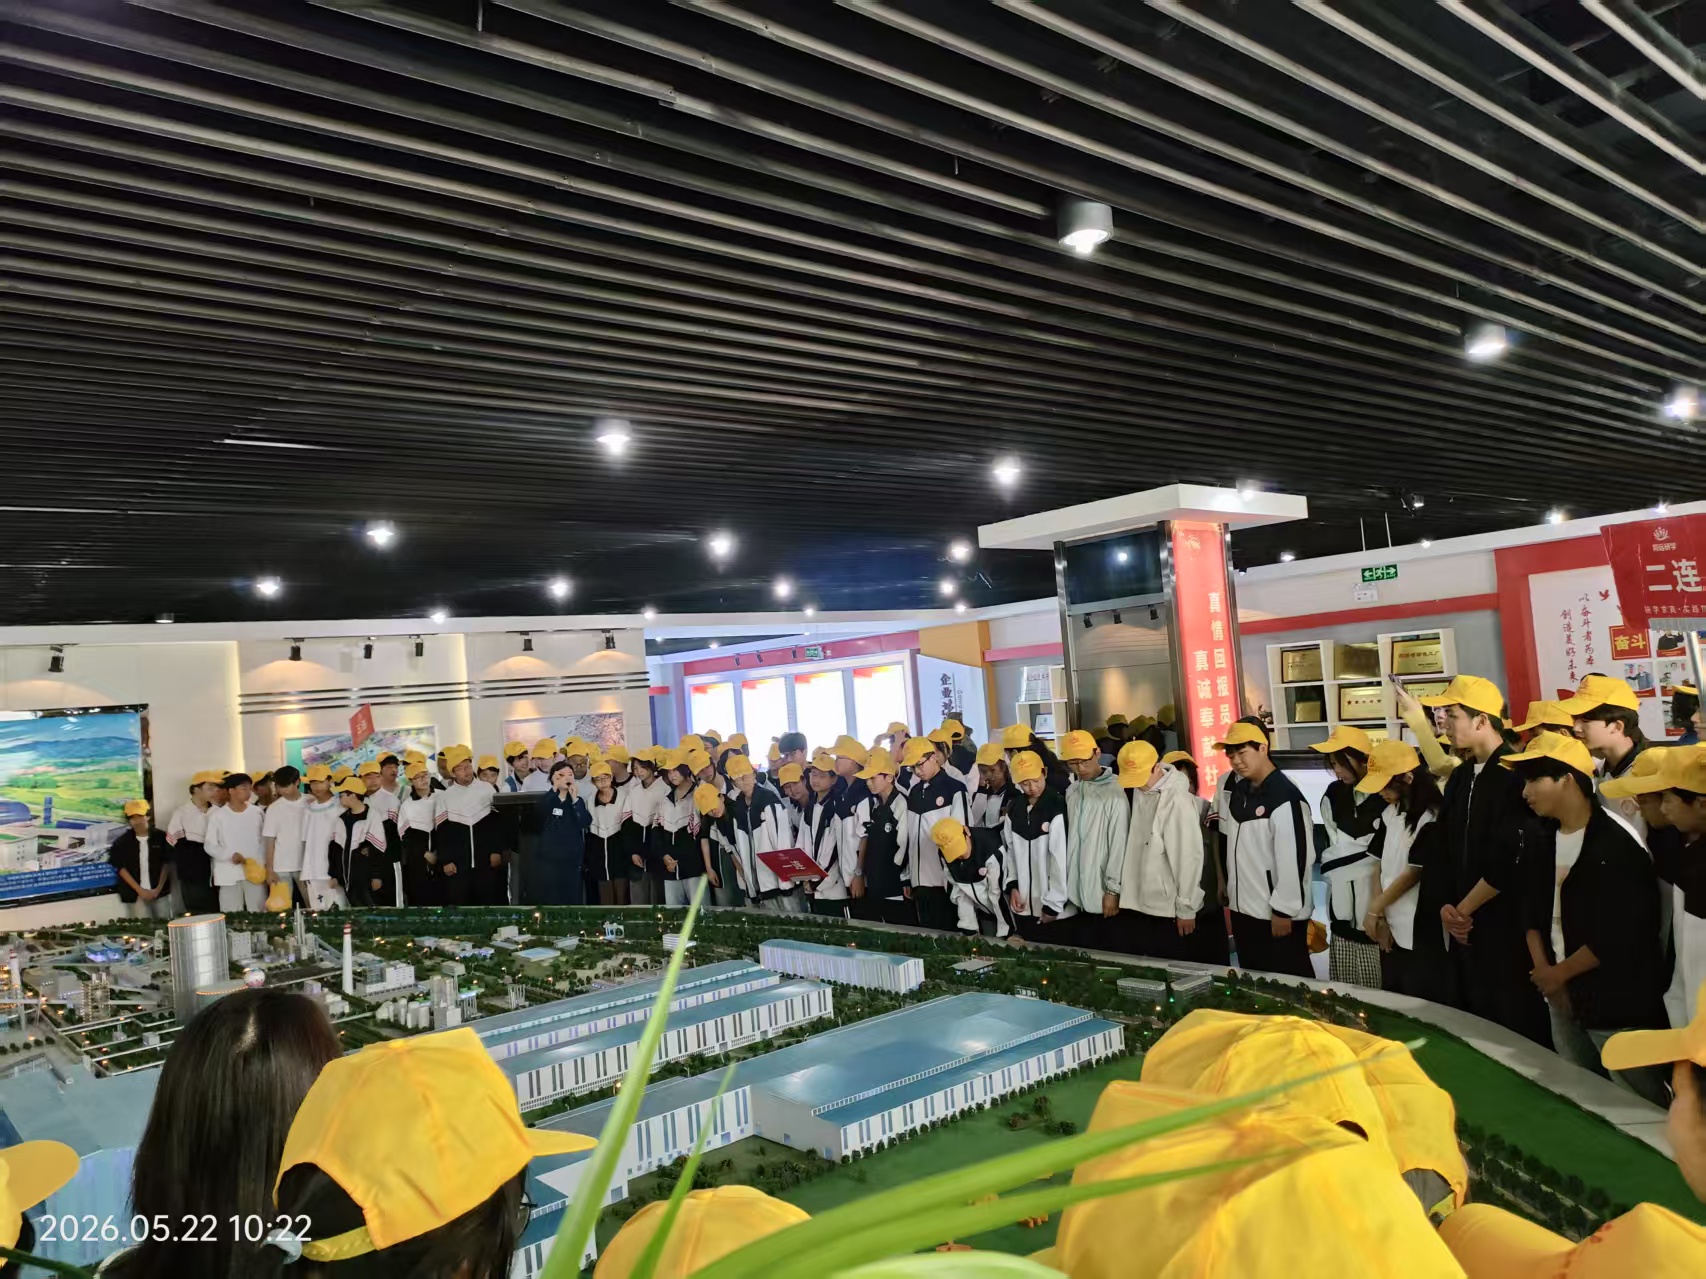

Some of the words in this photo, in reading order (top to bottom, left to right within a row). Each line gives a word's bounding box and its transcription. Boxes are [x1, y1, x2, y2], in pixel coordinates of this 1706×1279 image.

[1646, 558, 1703, 593] 二连
[1207, 591, 1230, 745] 真情回报员
[1560, 608, 1579, 683] 创造美好未来
